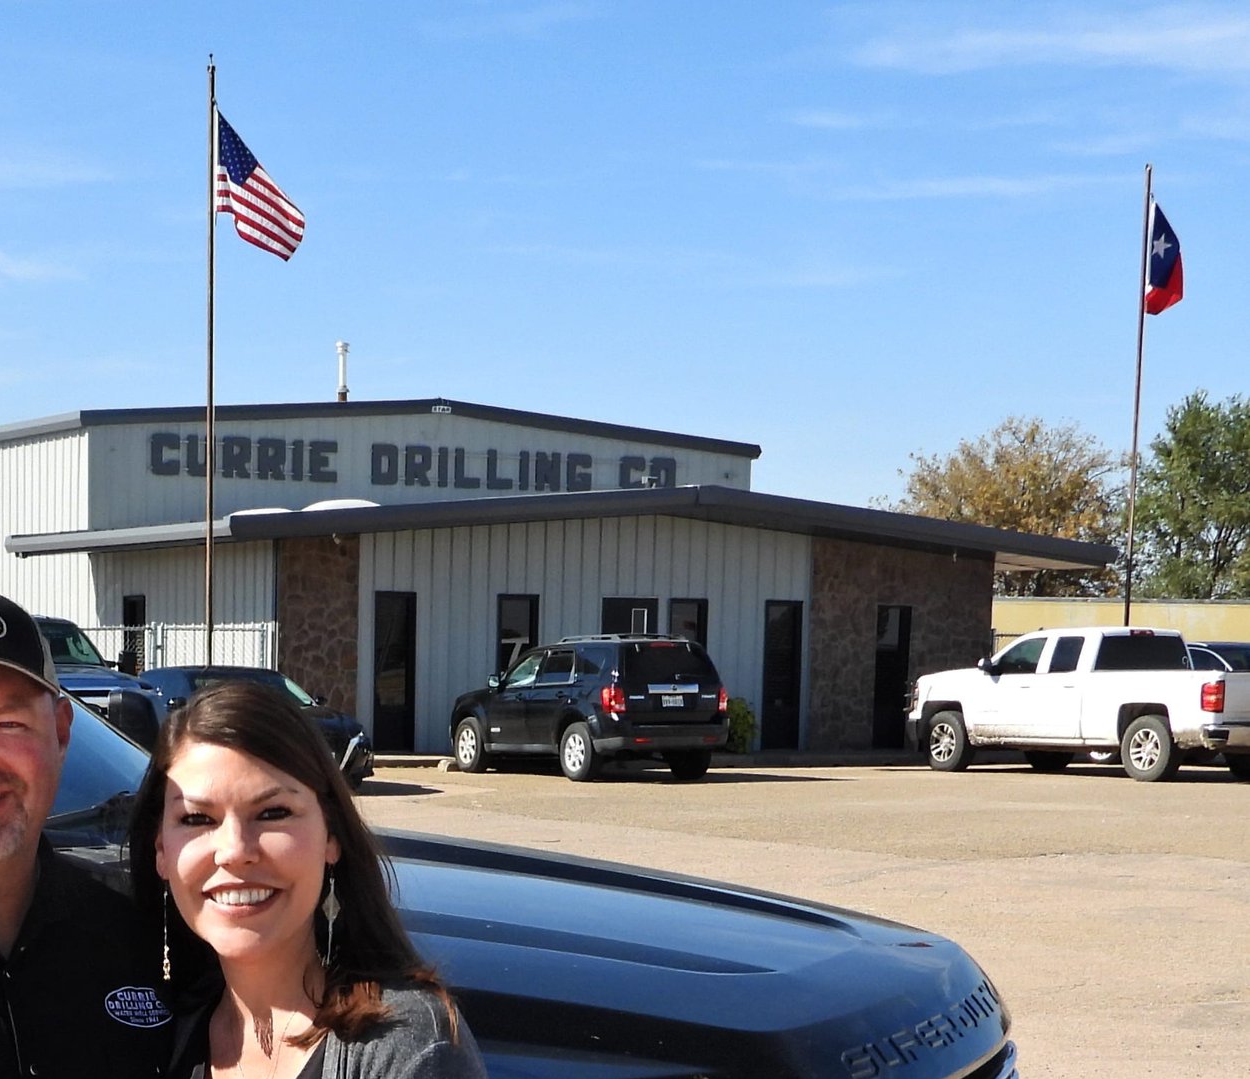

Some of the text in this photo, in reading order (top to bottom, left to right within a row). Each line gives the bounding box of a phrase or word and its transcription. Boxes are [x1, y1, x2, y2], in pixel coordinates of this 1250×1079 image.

[150, 432, 676, 492] CURRIE DRILLING CO
[116, 991, 157, 1001] CURRIE
[108, 1000, 153, 1010] DRILLING
